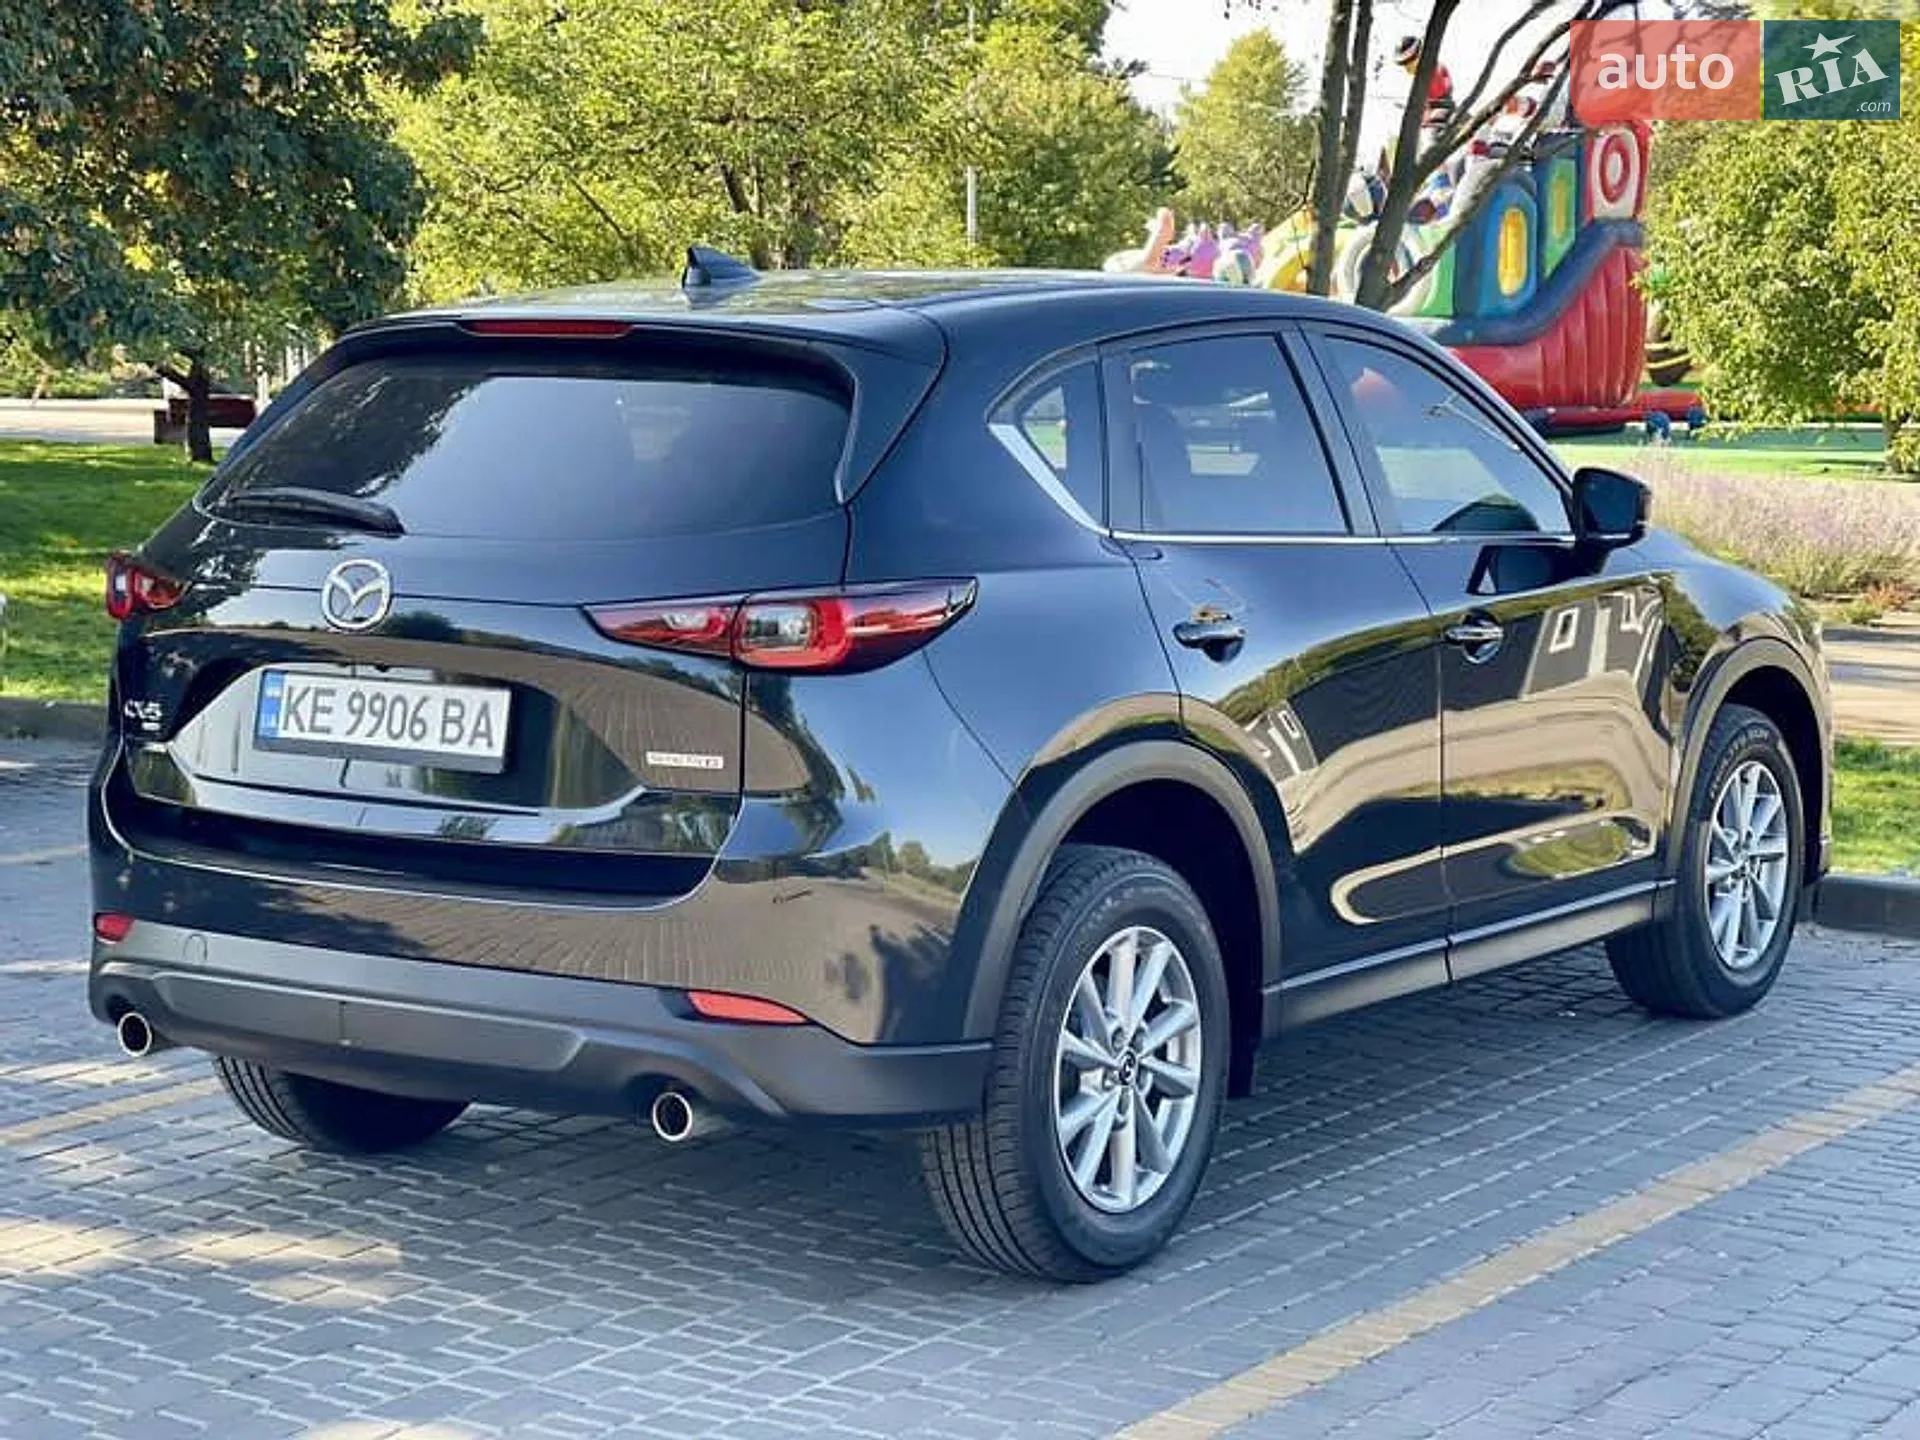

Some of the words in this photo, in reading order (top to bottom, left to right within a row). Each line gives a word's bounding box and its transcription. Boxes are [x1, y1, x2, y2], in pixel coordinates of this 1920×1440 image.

[283, 686, 336, 734] KE
[345, 690, 429, 741] 9906
[440, 698, 494, 748] BA
